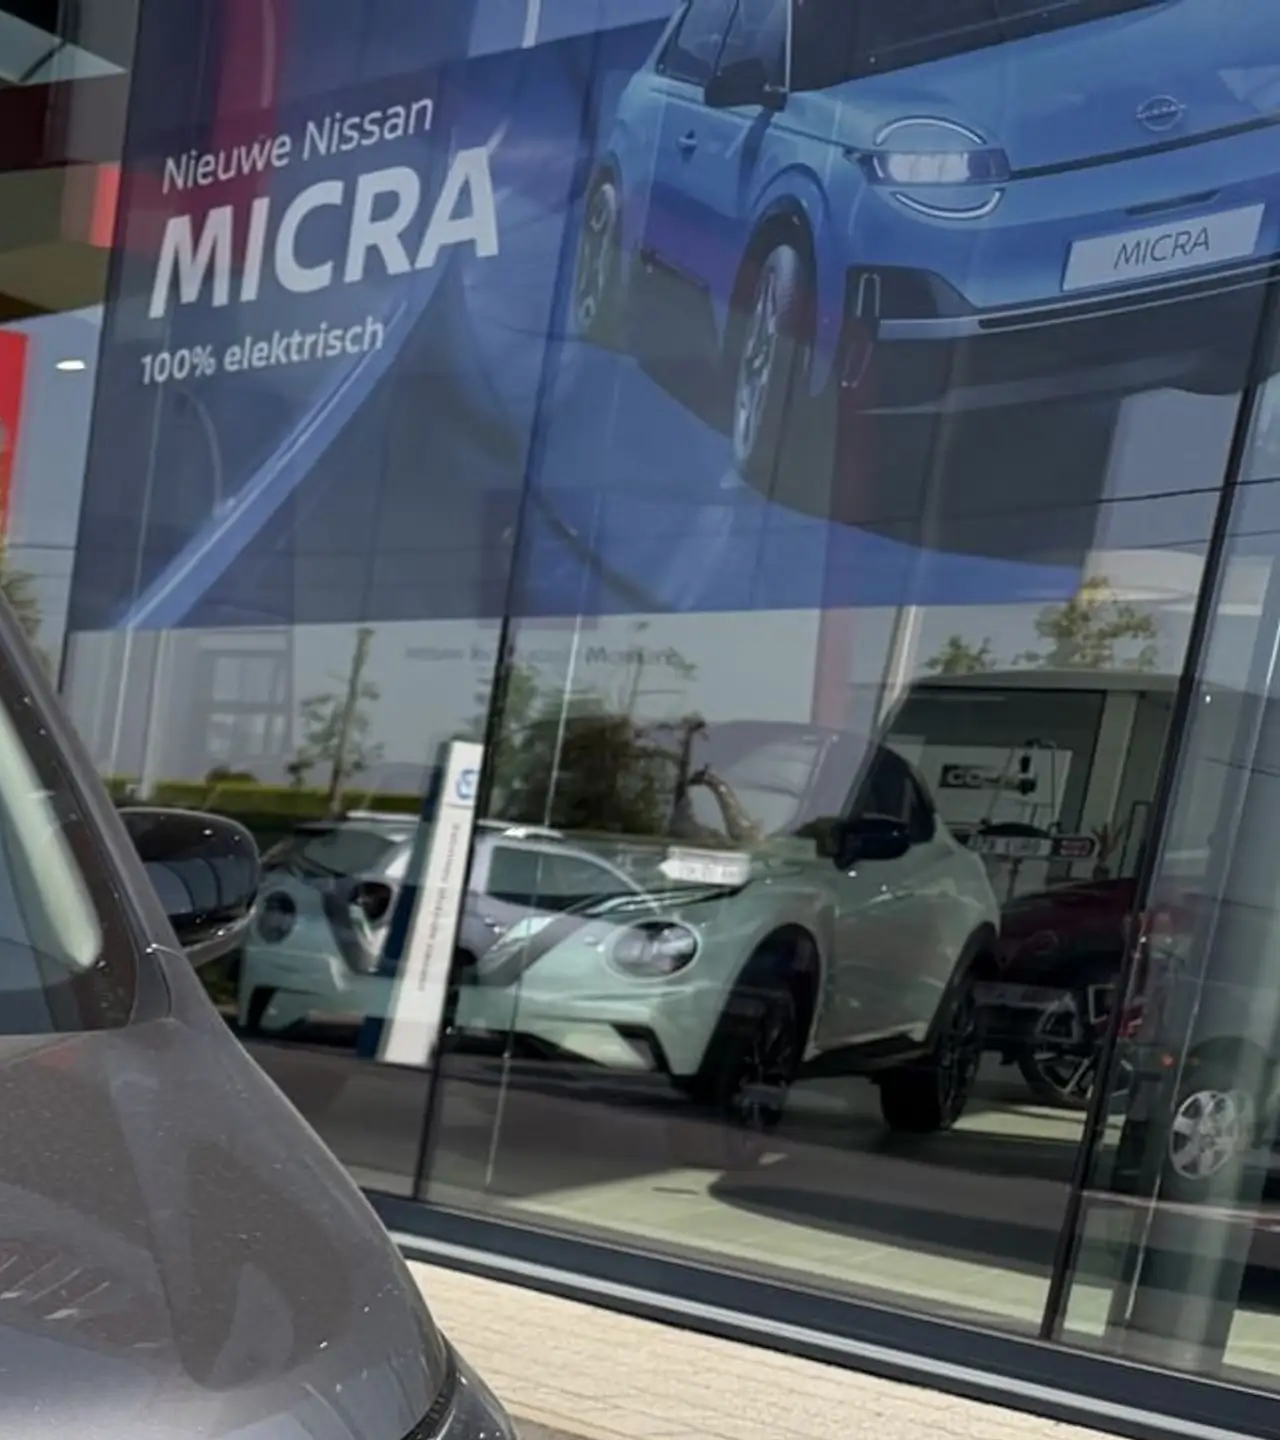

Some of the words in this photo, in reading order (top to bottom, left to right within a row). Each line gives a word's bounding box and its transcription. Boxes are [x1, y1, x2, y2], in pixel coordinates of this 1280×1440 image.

[162, 133, 291, 194] Nieuwe
[303, 98, 433, 160] Nissan
[148, 147, 499, 319] MICRA
[1113, 226, 1210, 270] MICRA
[141, 345, 216, 385] 100%
[223, 316, 385, 372] elektrisch
